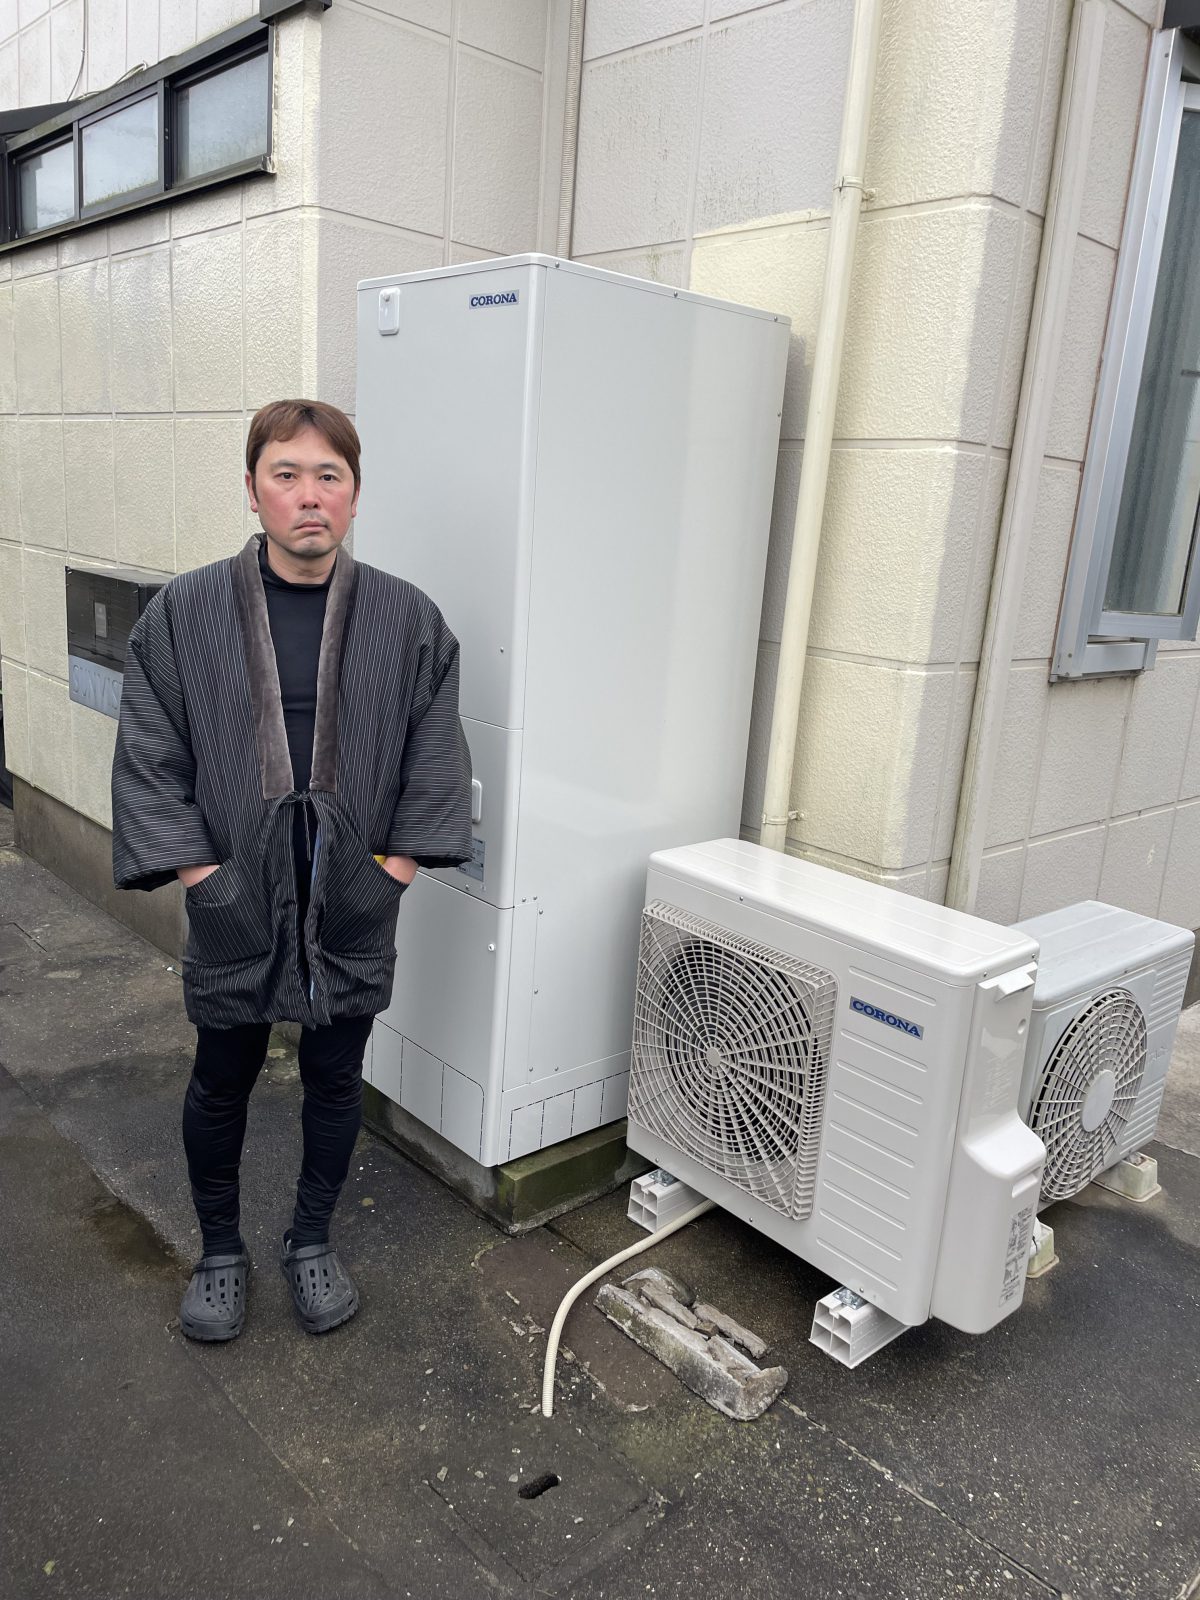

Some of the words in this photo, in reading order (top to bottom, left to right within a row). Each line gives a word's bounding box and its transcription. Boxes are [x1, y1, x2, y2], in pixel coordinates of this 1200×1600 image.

[470, 292, 518, 307] CORONA
[72, 664, 122, 710] SUNVIS
[852, 1000, 921, 1038] CORONA
